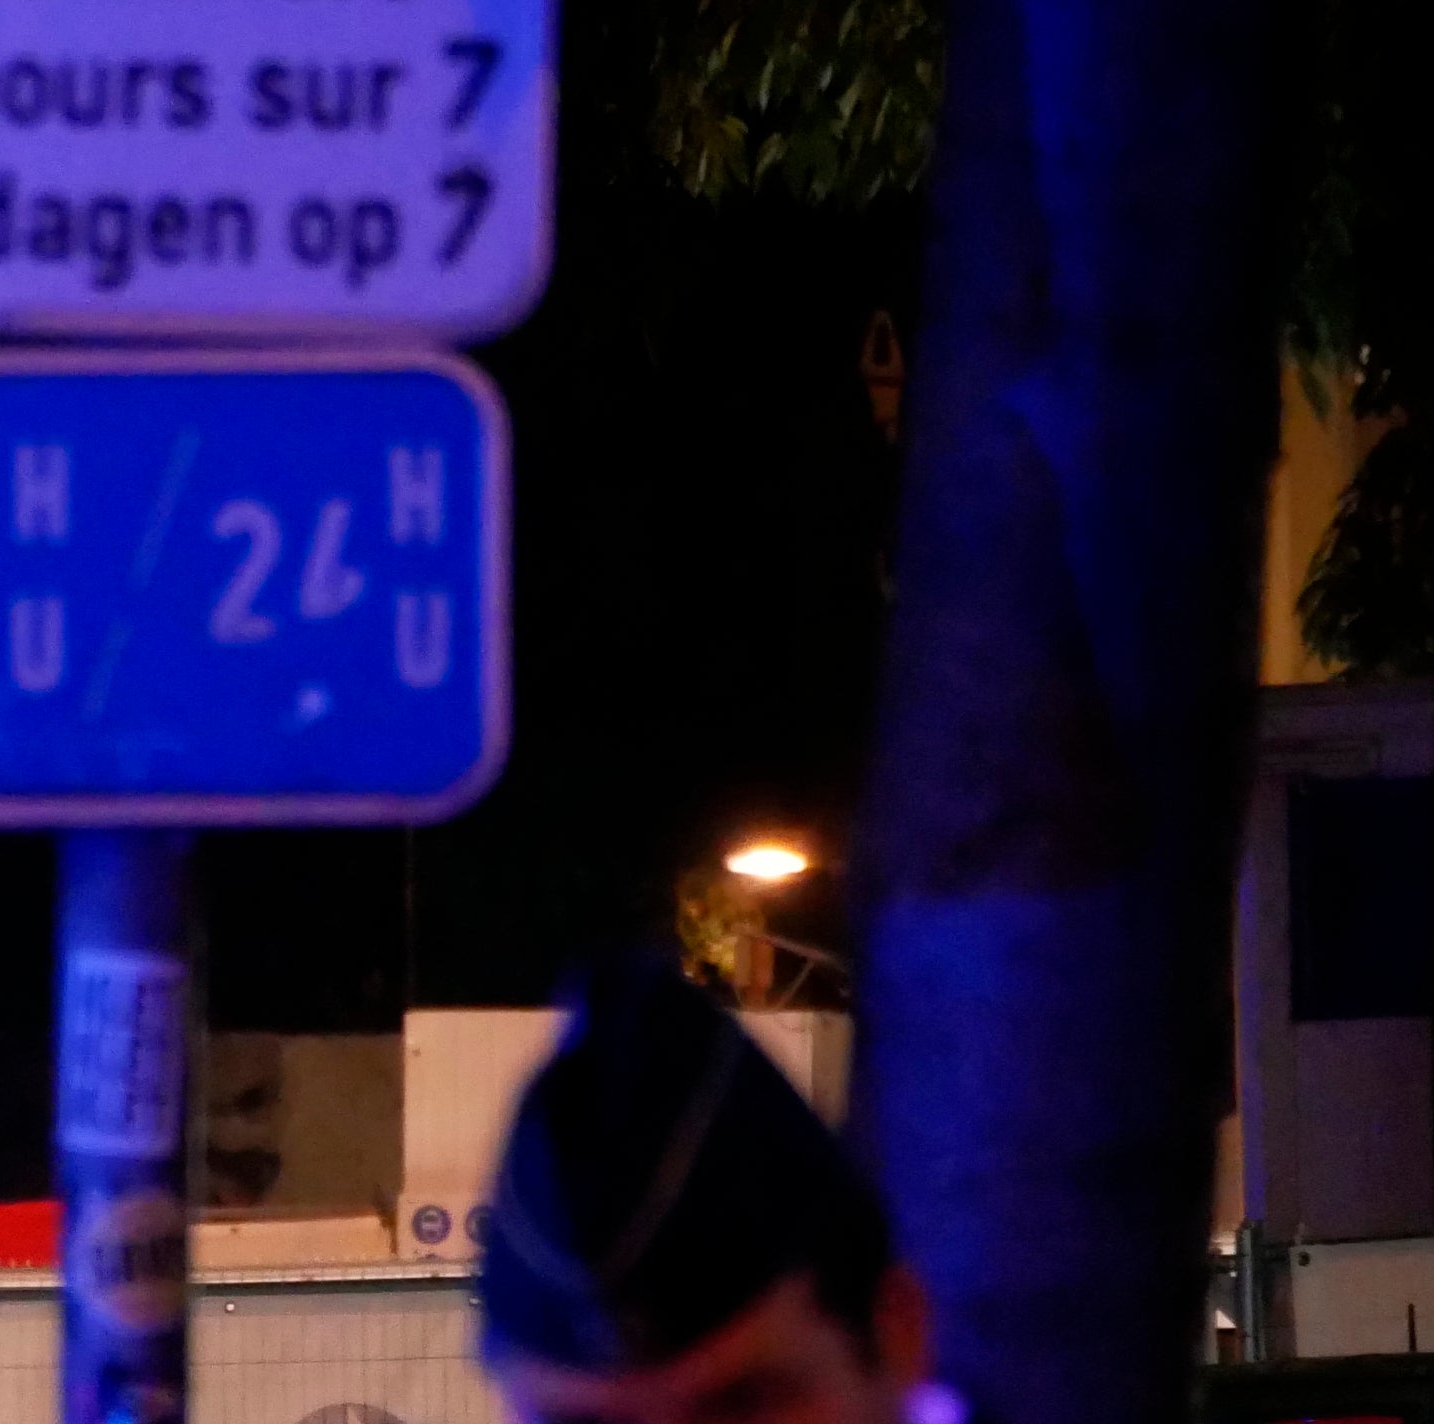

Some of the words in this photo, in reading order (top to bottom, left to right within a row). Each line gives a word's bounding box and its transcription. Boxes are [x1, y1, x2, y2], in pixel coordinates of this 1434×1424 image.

[249, 60, 408, 130] sur
[444, 38, 504, 132] 7
[288, 193, 400, 289] op
[436, 163, 496, 268] 7
[13, 444, 69, 541] H
[389, 446, 444, 543] H
[10, 598, 64, 691] U
[396, 594, 450, 687] U
